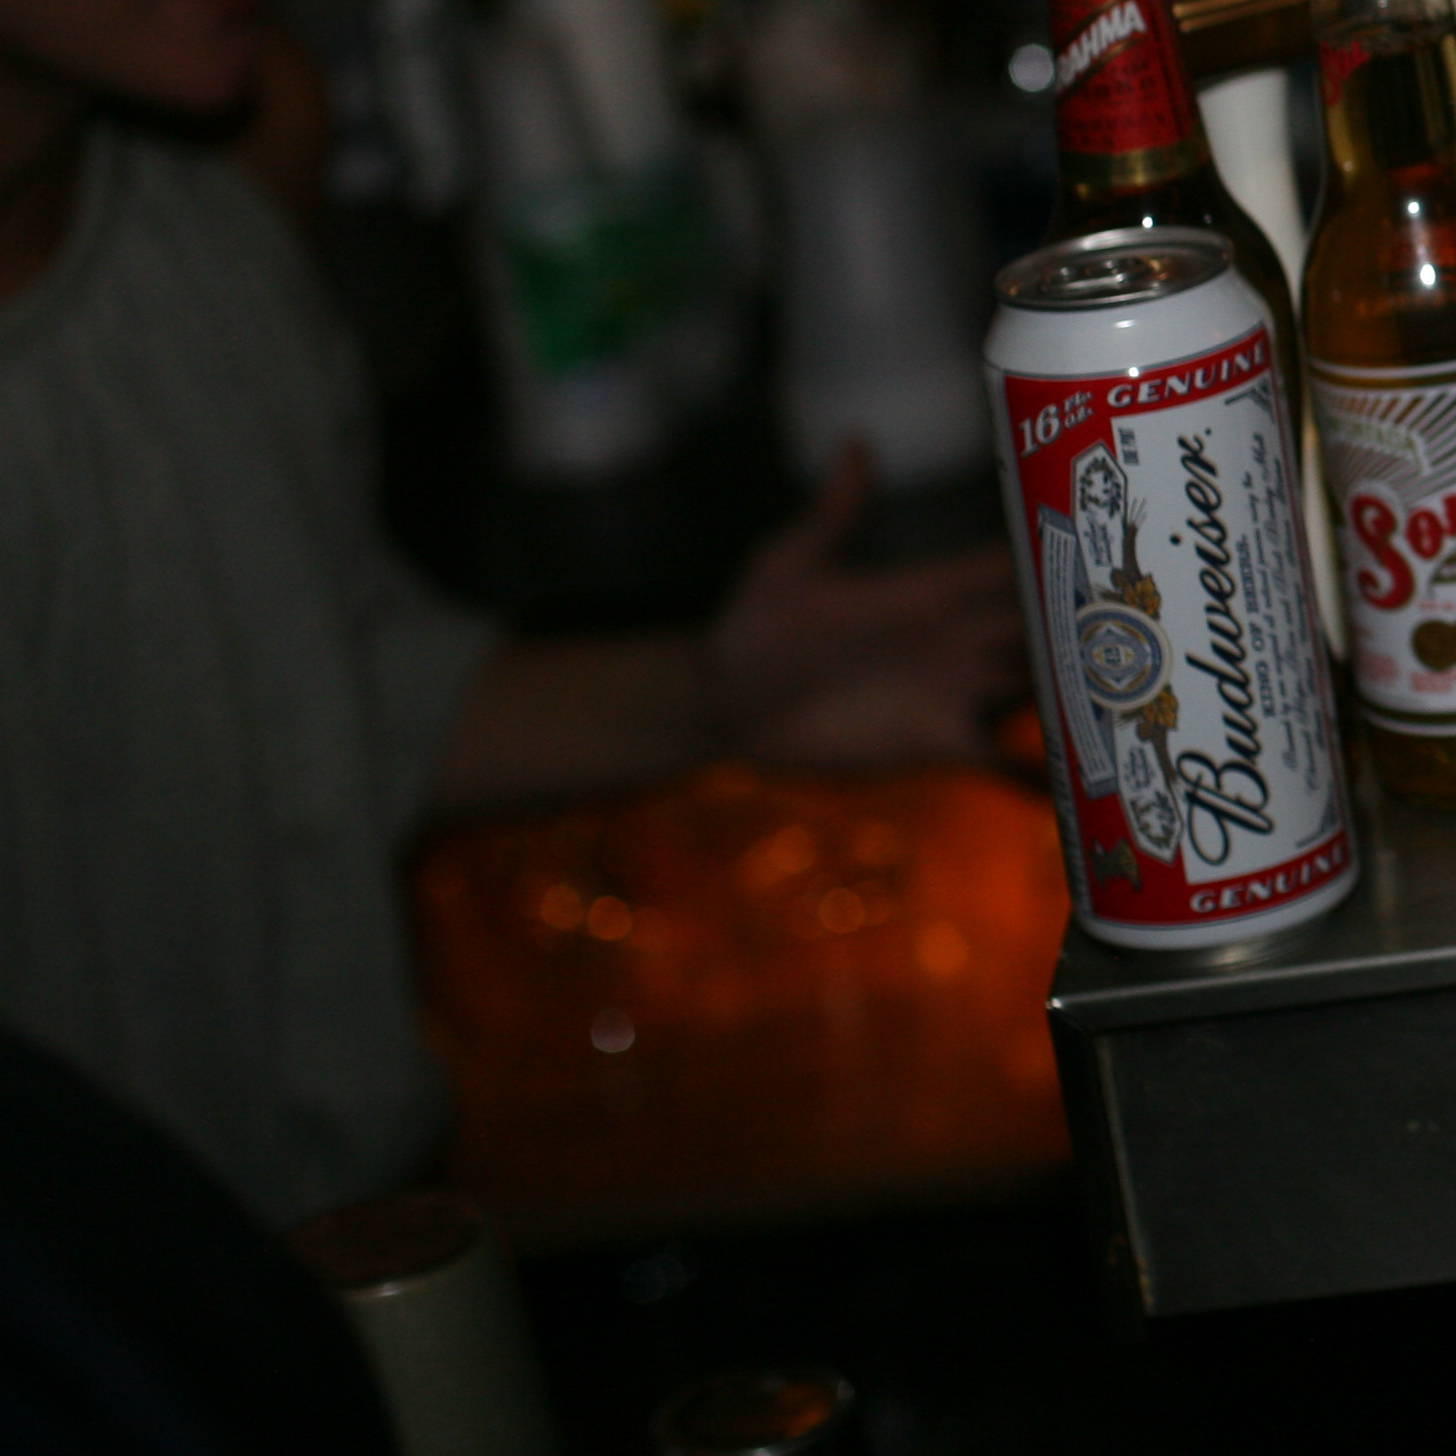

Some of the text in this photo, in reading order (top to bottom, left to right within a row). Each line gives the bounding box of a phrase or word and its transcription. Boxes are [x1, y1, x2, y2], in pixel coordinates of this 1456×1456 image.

[1018, 399, 1062, 459] 16
[1175, 426, 1275, 867] Budweiser
[1253, 625, 1264, 651] OF
[1257, 661, 1274, 717] KING
